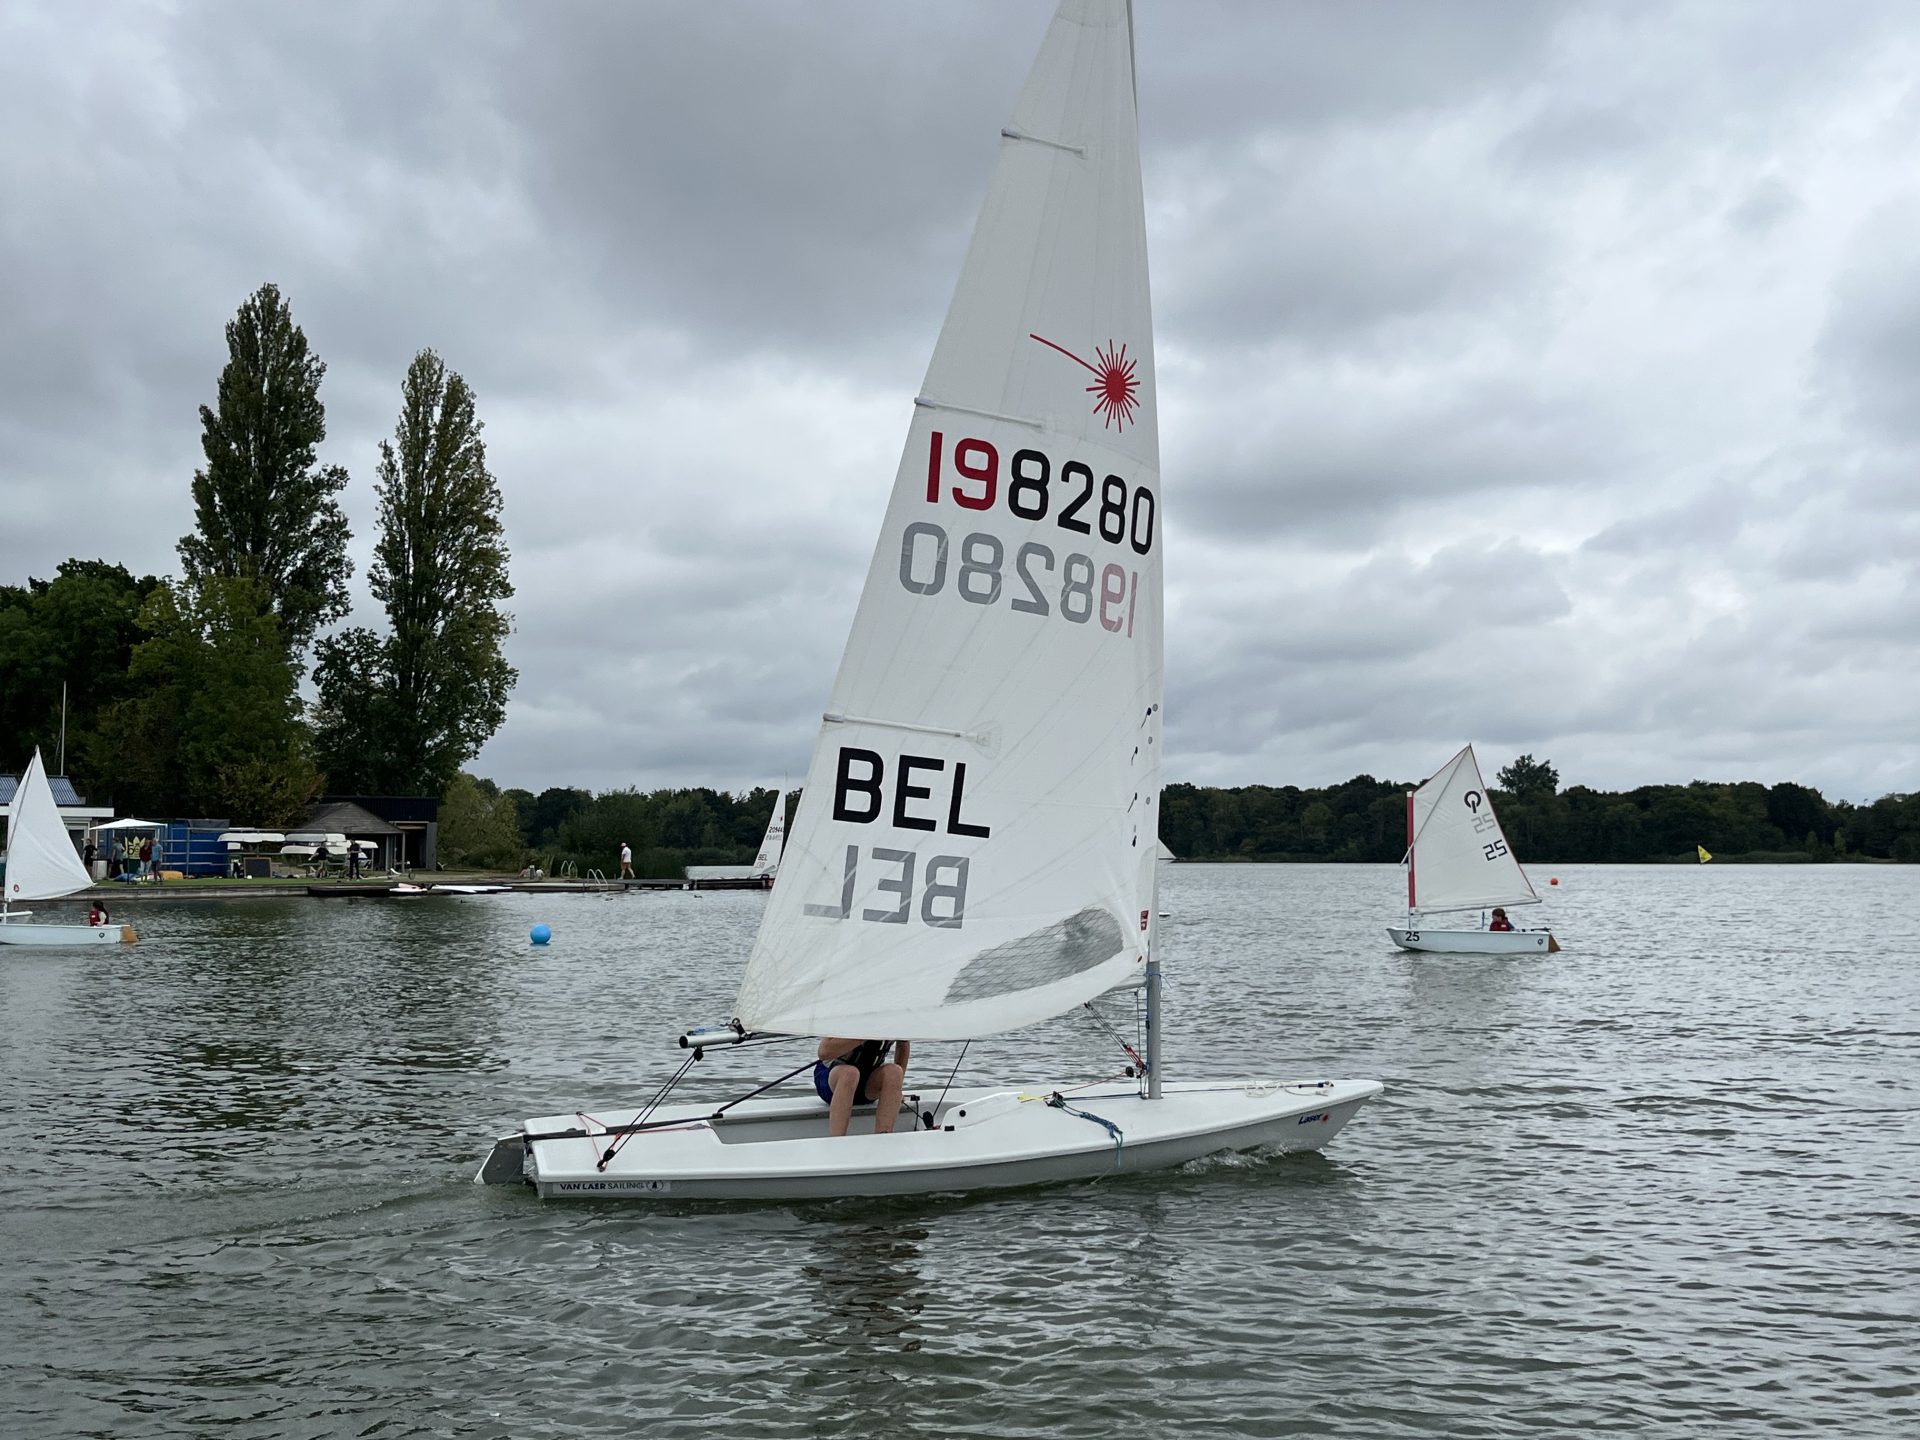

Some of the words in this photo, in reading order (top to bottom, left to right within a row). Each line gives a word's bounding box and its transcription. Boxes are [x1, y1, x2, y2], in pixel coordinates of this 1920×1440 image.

[926, 431, 1155, 555] 198280
[833, 746, 990, 838] BEL
[1471, 813, 1496, 834] 25
[1483, 839, 1507, 861] 25
[1405, 930, 1420, 941] 25
[582, 1182, 606, 1190] LAER
[607, 1181, 643, 1189] SAILING
